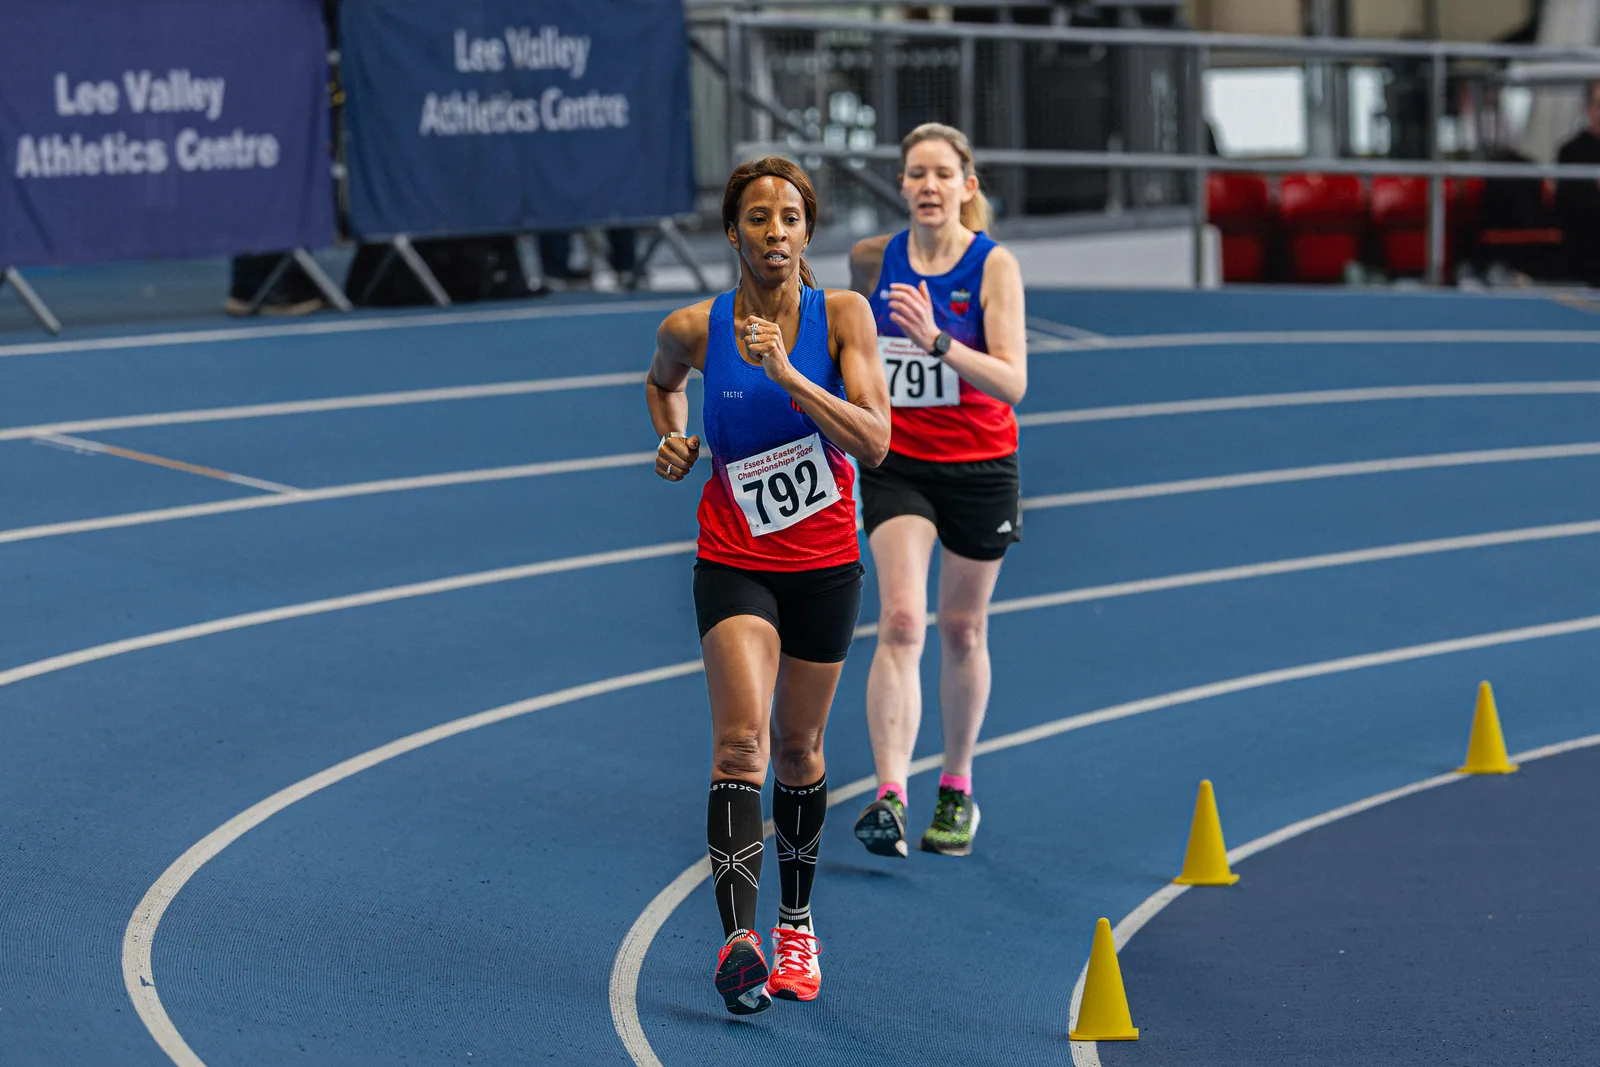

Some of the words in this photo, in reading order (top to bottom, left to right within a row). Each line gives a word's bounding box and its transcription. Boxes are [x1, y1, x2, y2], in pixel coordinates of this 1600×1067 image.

[454, 28, 505, 73] Lee
[505, 25, 591, 79] Valley
[55, 72, 120, 116] Lee
[123, 69, 225, 121] Valley
[419, 89, 540, 137] Athletics
[540, 86, 629, 132] Centre
[16, 131, 168, 178] Athletics
[175, 128, 279, 172] Centre
[886, 358, 944, 399] 791
[737, 456, 795, 481] Championships
[796, 445, 814, 459] 2026
[743, 458, 765, 470] Essex
[766, 455, 772, 463] &
[773, 443, 802, 460] Eastern
[742, 460, 827, 525] 792
